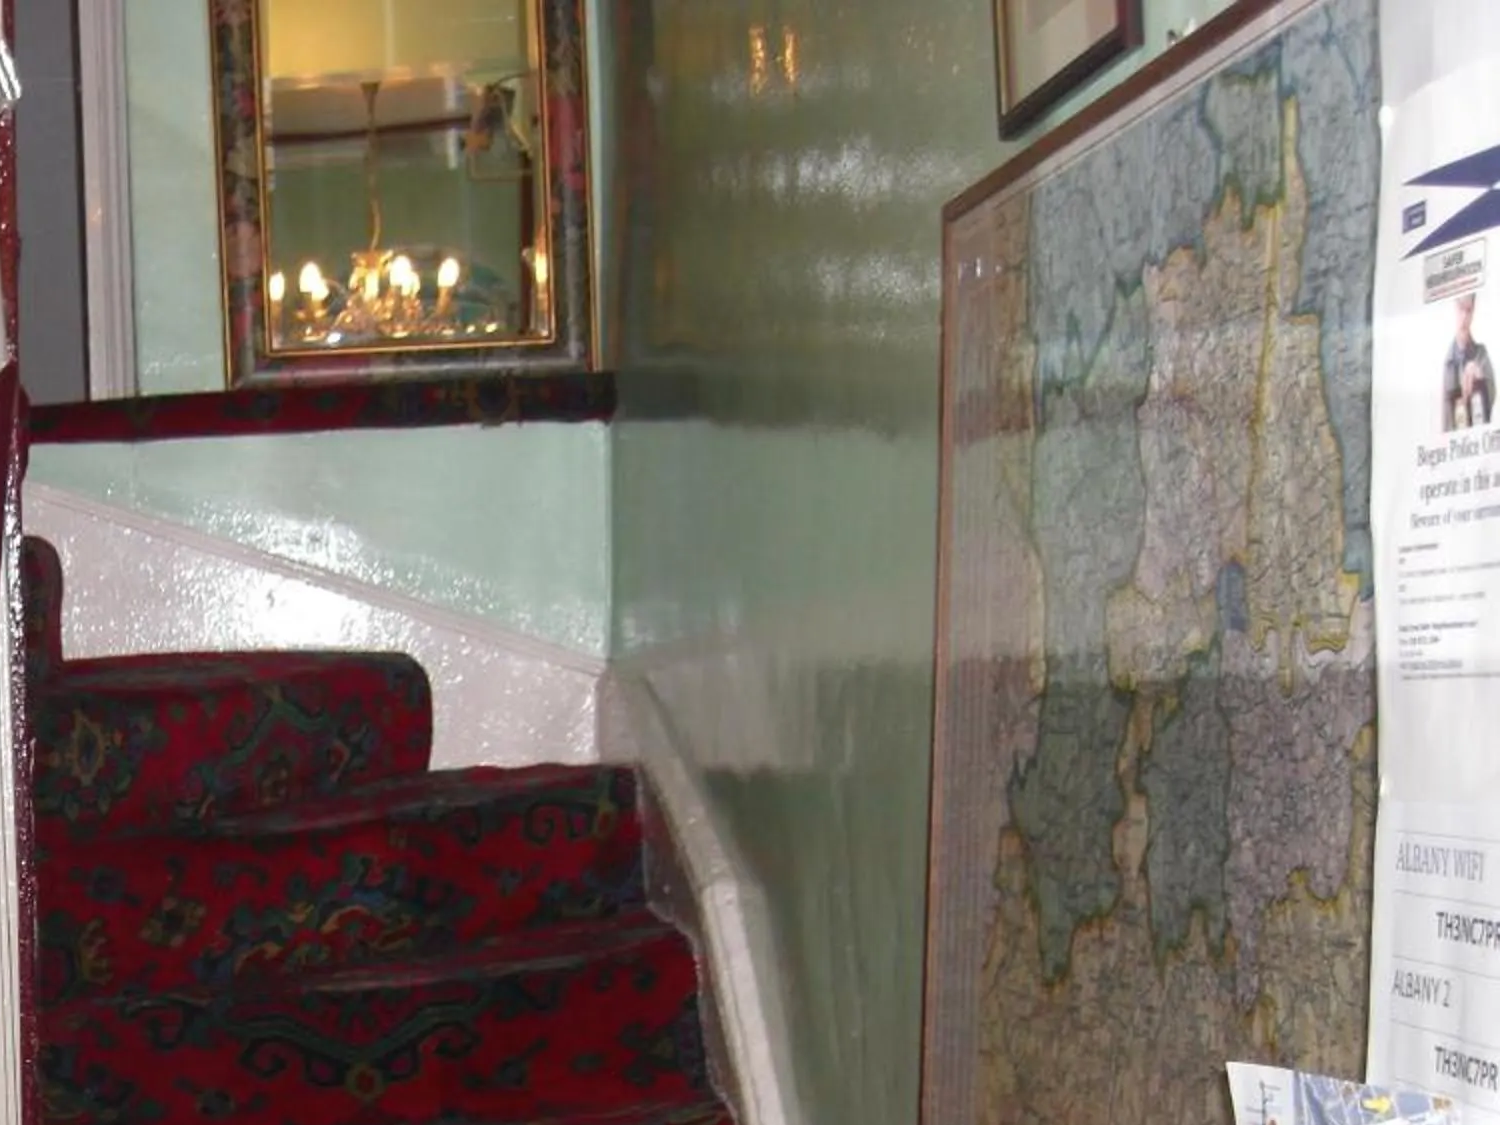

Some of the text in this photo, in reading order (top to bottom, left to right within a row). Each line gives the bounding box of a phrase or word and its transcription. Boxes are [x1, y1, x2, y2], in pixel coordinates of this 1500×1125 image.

[1396, 841, 1484, 883] ALBANY WIFI
[1391, 968, 1451, 1008] ALBANY 2
[1434, 1045, 1499, 1093] TH3NC7PR
